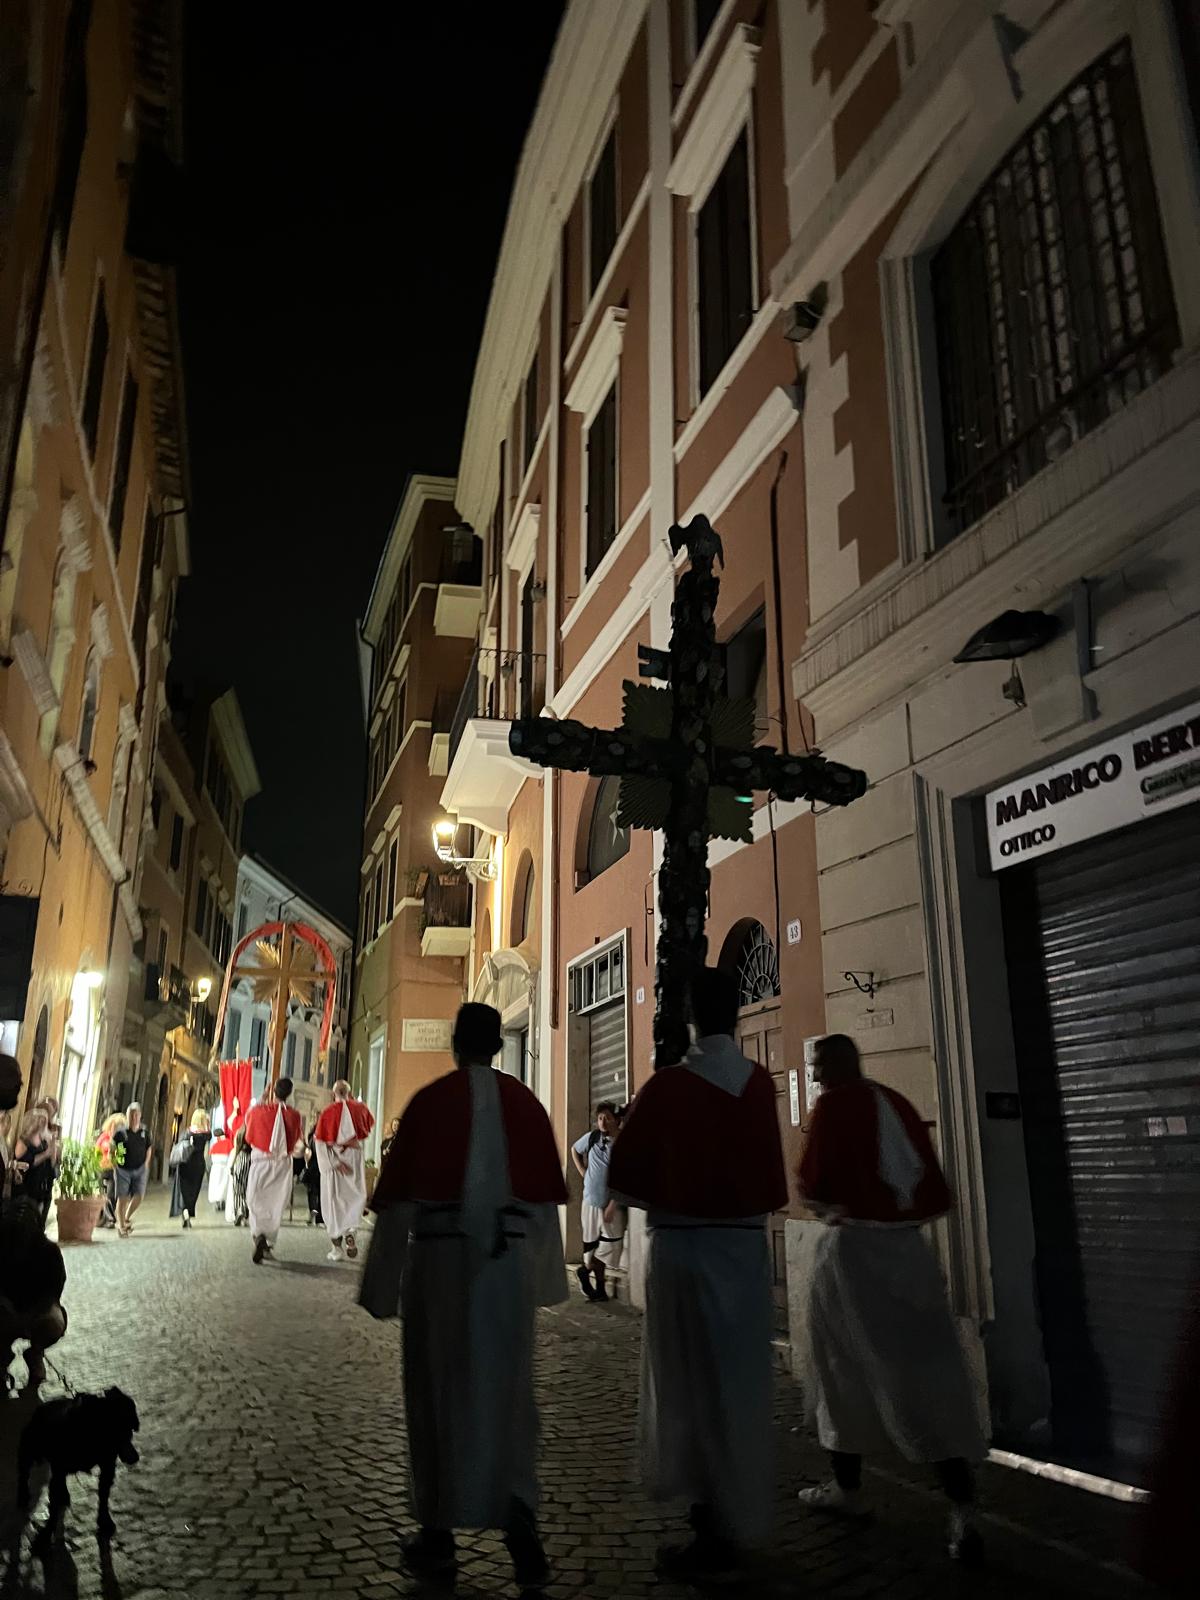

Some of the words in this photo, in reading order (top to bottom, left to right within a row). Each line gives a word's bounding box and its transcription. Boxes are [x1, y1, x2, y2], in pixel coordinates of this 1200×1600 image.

[996, 754, 1122, 826] MANRICO
[1000, 824, 1056, 856] OTTICO
[789, 925, 799, 939] 43
